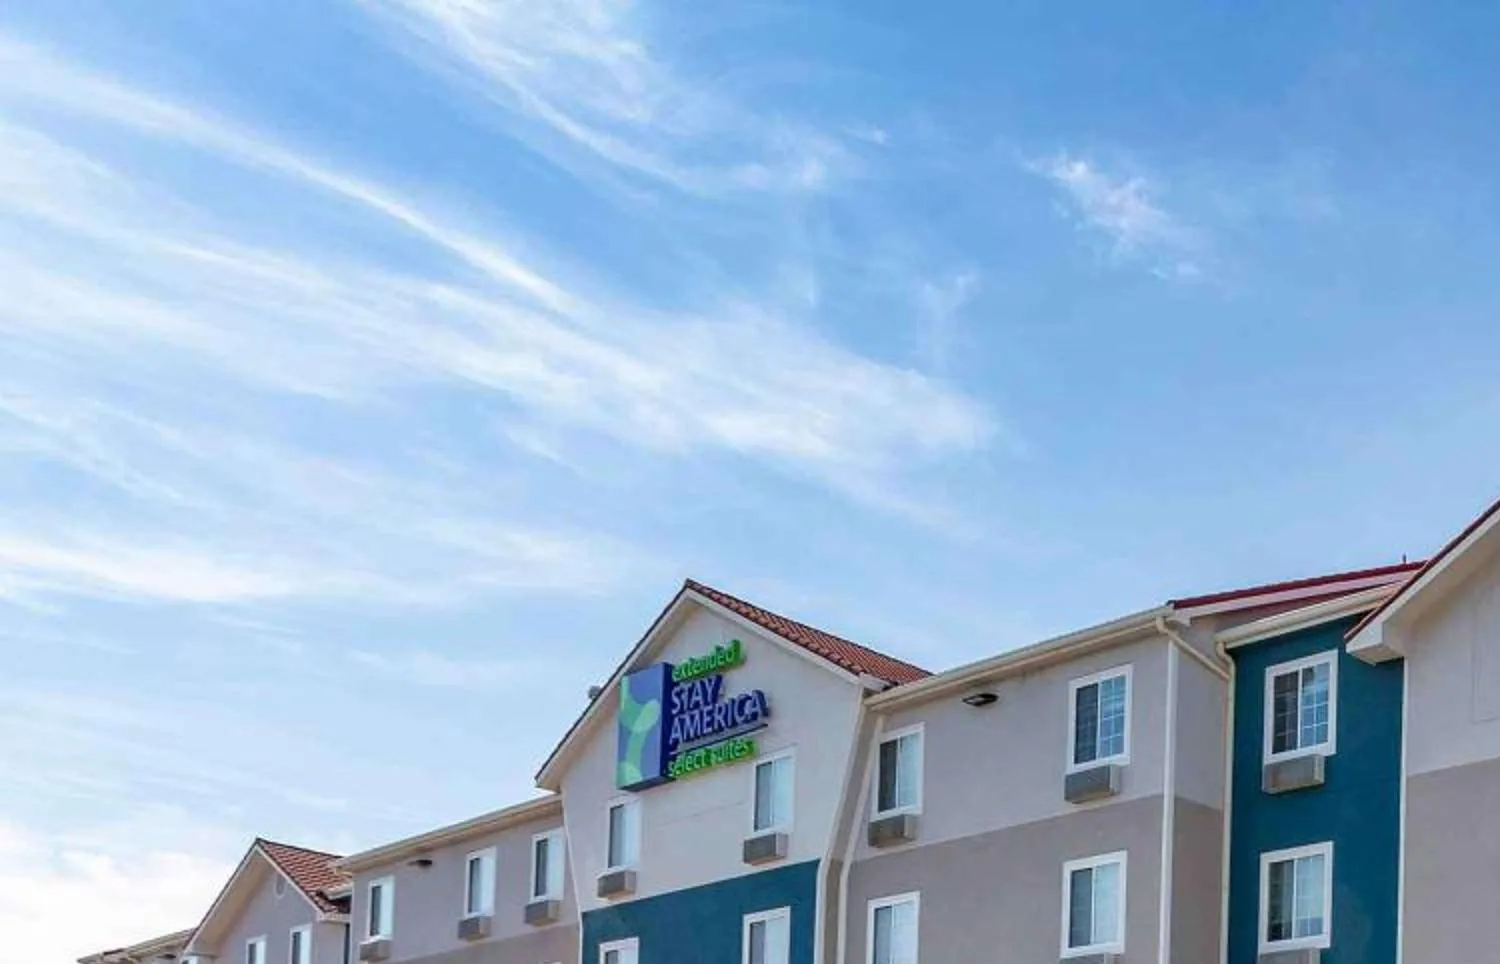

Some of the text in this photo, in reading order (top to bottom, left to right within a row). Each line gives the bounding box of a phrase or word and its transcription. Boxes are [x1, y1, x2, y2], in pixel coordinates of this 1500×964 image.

[672, 639, 741, 681] extended
[672, 674, 722, 714] STAY
[669, 690, 767, 744] AMERICA
[668, 748, 709, 776] select
